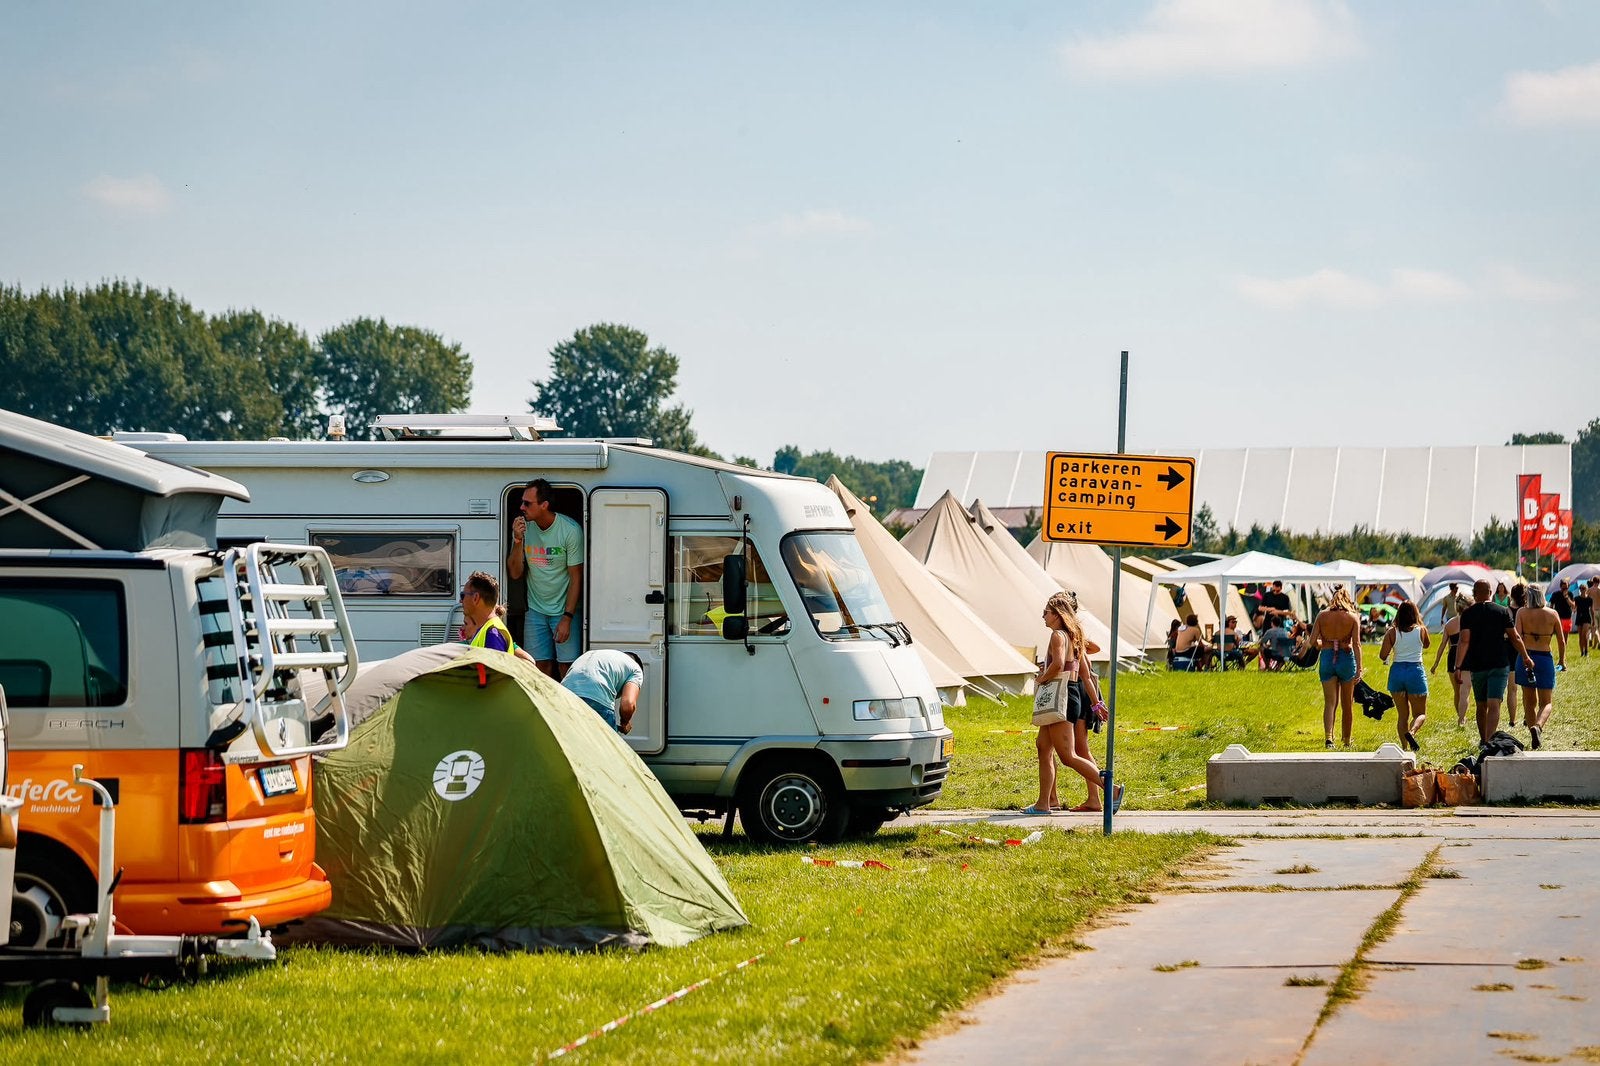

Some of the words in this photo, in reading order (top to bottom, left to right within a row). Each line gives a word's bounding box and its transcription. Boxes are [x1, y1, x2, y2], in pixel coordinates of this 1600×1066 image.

[1060, 461, 1141, 475] parkeren
[1059, 477, 1142, 490] caravan-
[1058, 492, 1136, 509] camping
[1524, 498, 1538, 520] D
[1056, 521, 1092, 534] exit
[1542, 512, 1556, 530] C
[49, 719, 124, 728] BEACH
[31, 804, 81, 814] BeachHostel
